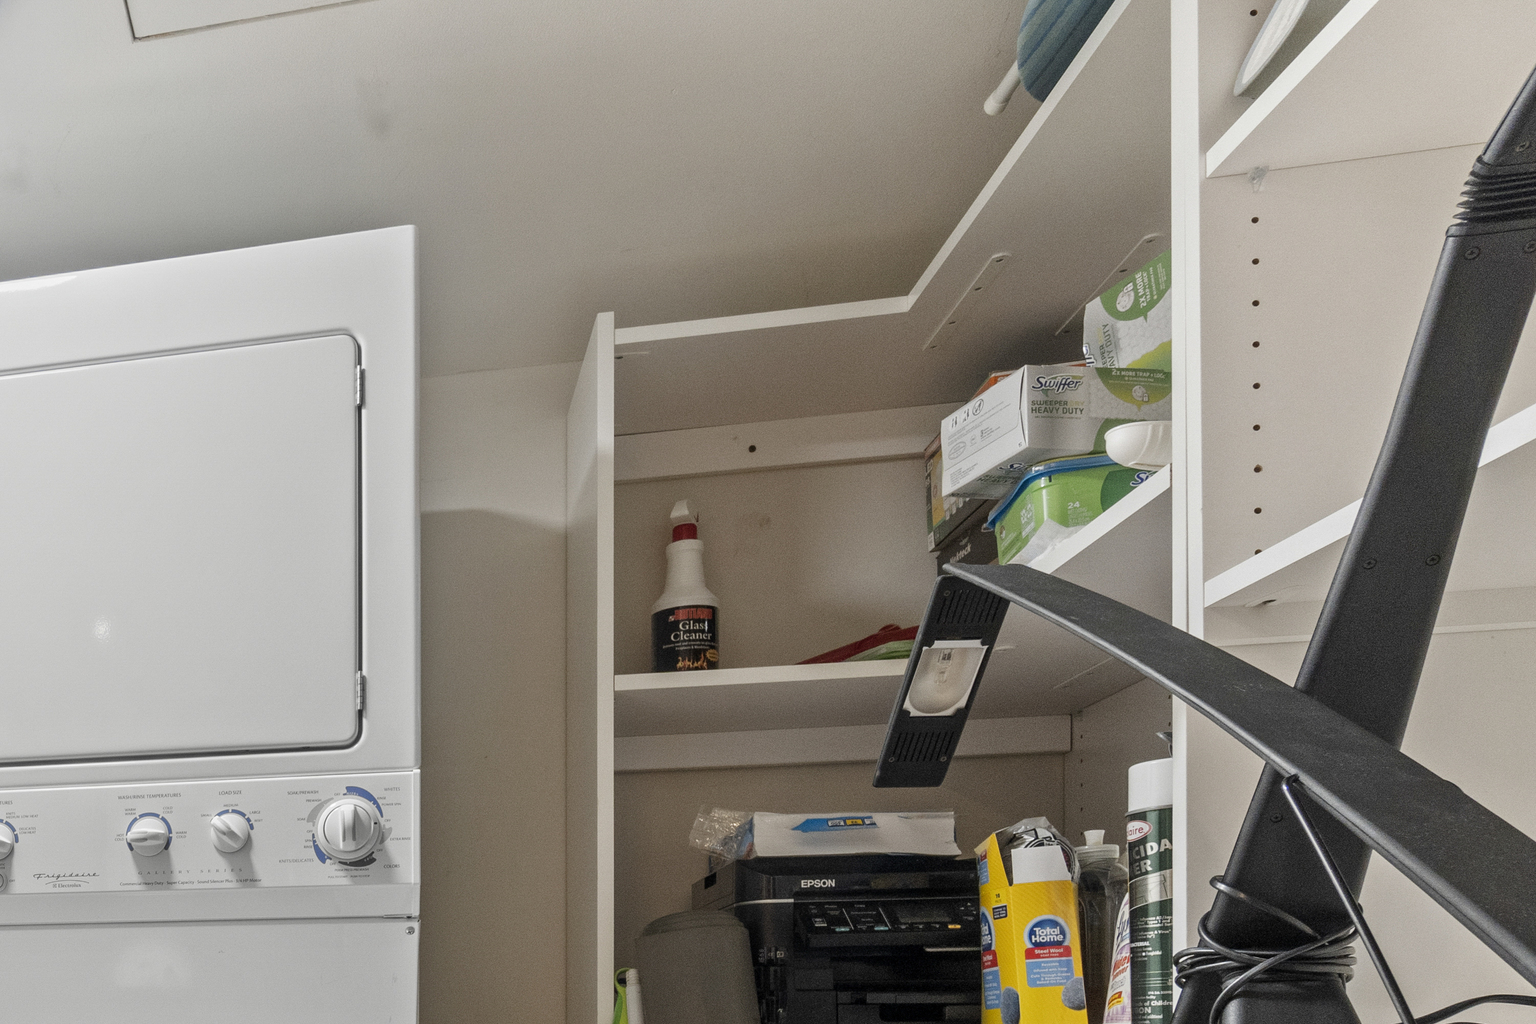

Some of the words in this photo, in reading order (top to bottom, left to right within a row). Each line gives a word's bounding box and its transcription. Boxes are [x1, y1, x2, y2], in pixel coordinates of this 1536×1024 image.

[1135, 272, 1145, 296] MORE
[1102, 323, 1113, 351] DUTY
[1031, 375, 1083, 393] Swiffer
[1031, 406, 1060, 415] HEAVY
[1062, 407, 1085, 415] DUTY
[1067, 501, 1080, 509] 24
[670, 631, 713, 642] Cleaner
[33, 871, 100, 881] Frigidaire
[800, 878, 836, 888] EPSON
[1033, 926, 1061, 936] Total
[1031, 933, 1064, 943] Home
